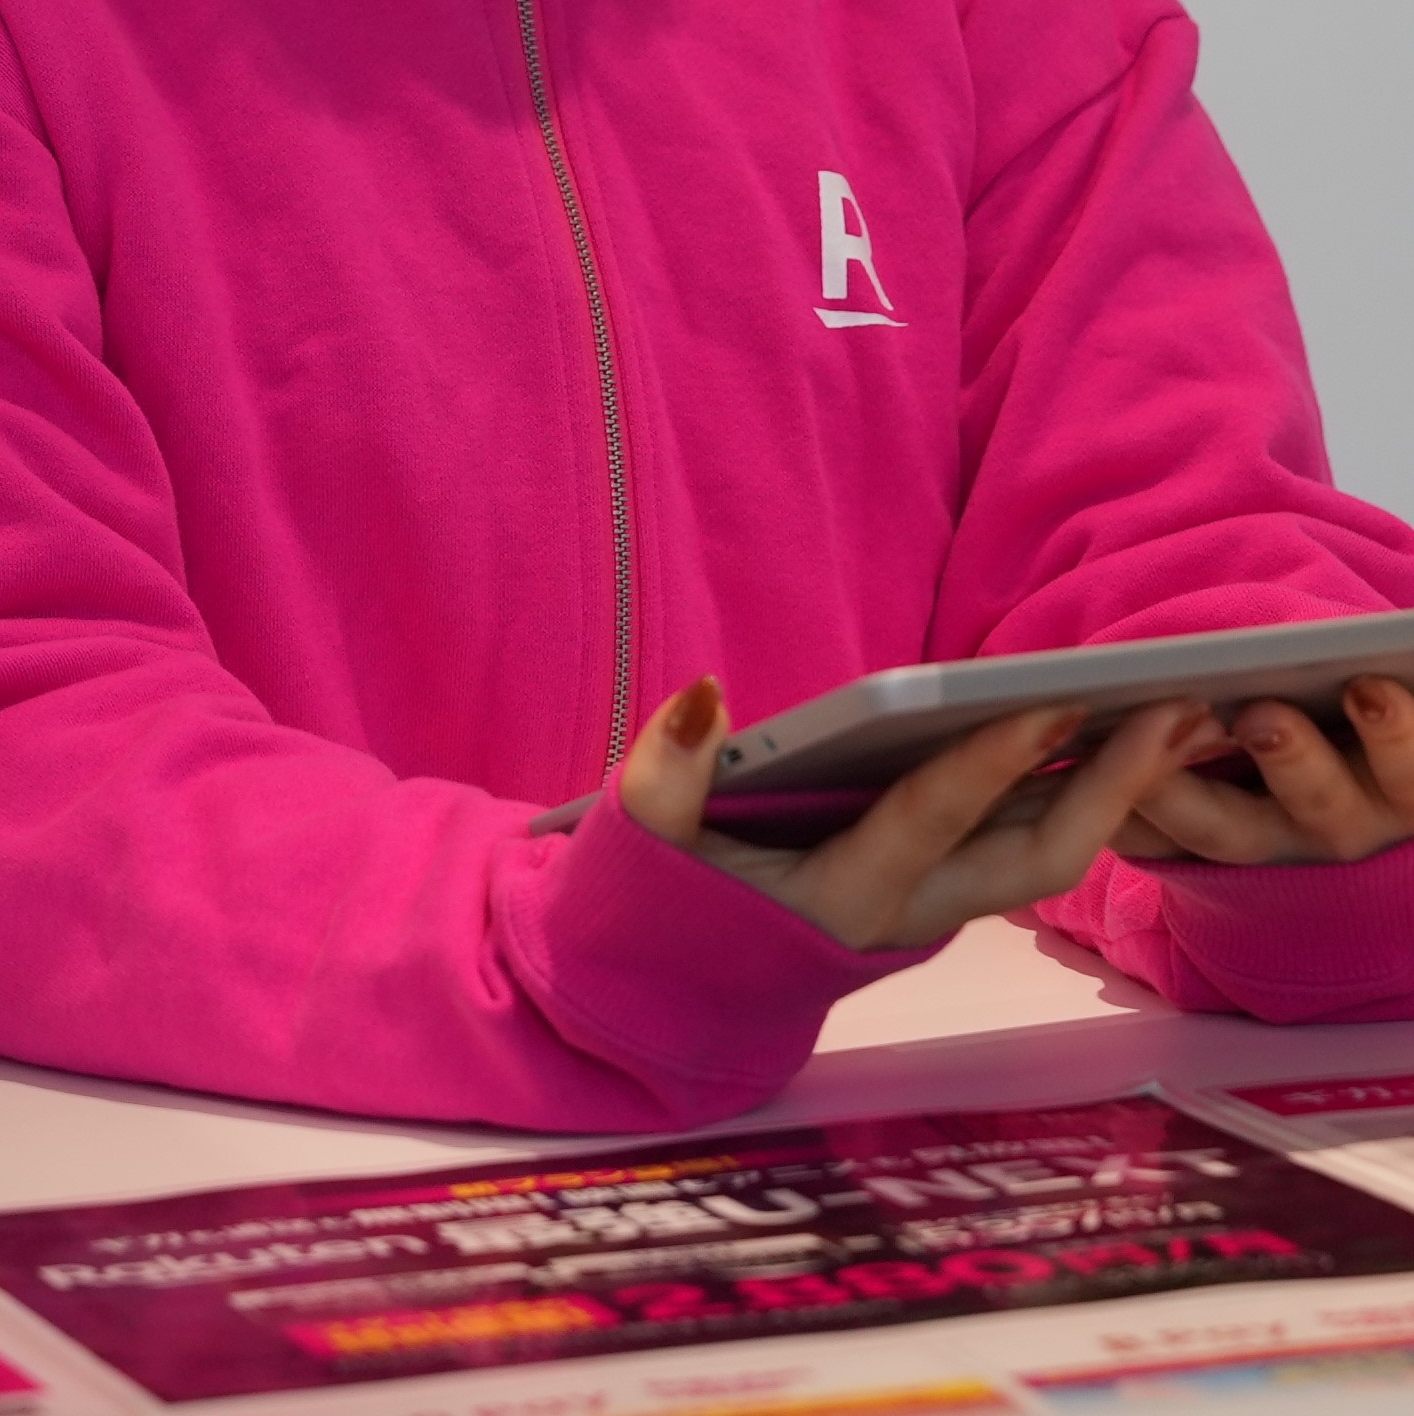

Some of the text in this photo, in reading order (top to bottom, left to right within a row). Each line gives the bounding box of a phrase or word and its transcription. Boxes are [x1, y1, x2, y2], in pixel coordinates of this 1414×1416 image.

[813, 170, 908, 328] R
[40, 1234, 428, 1292] Rakuten
[436, 1147, 1241, 1255] 最強U-NEXT
